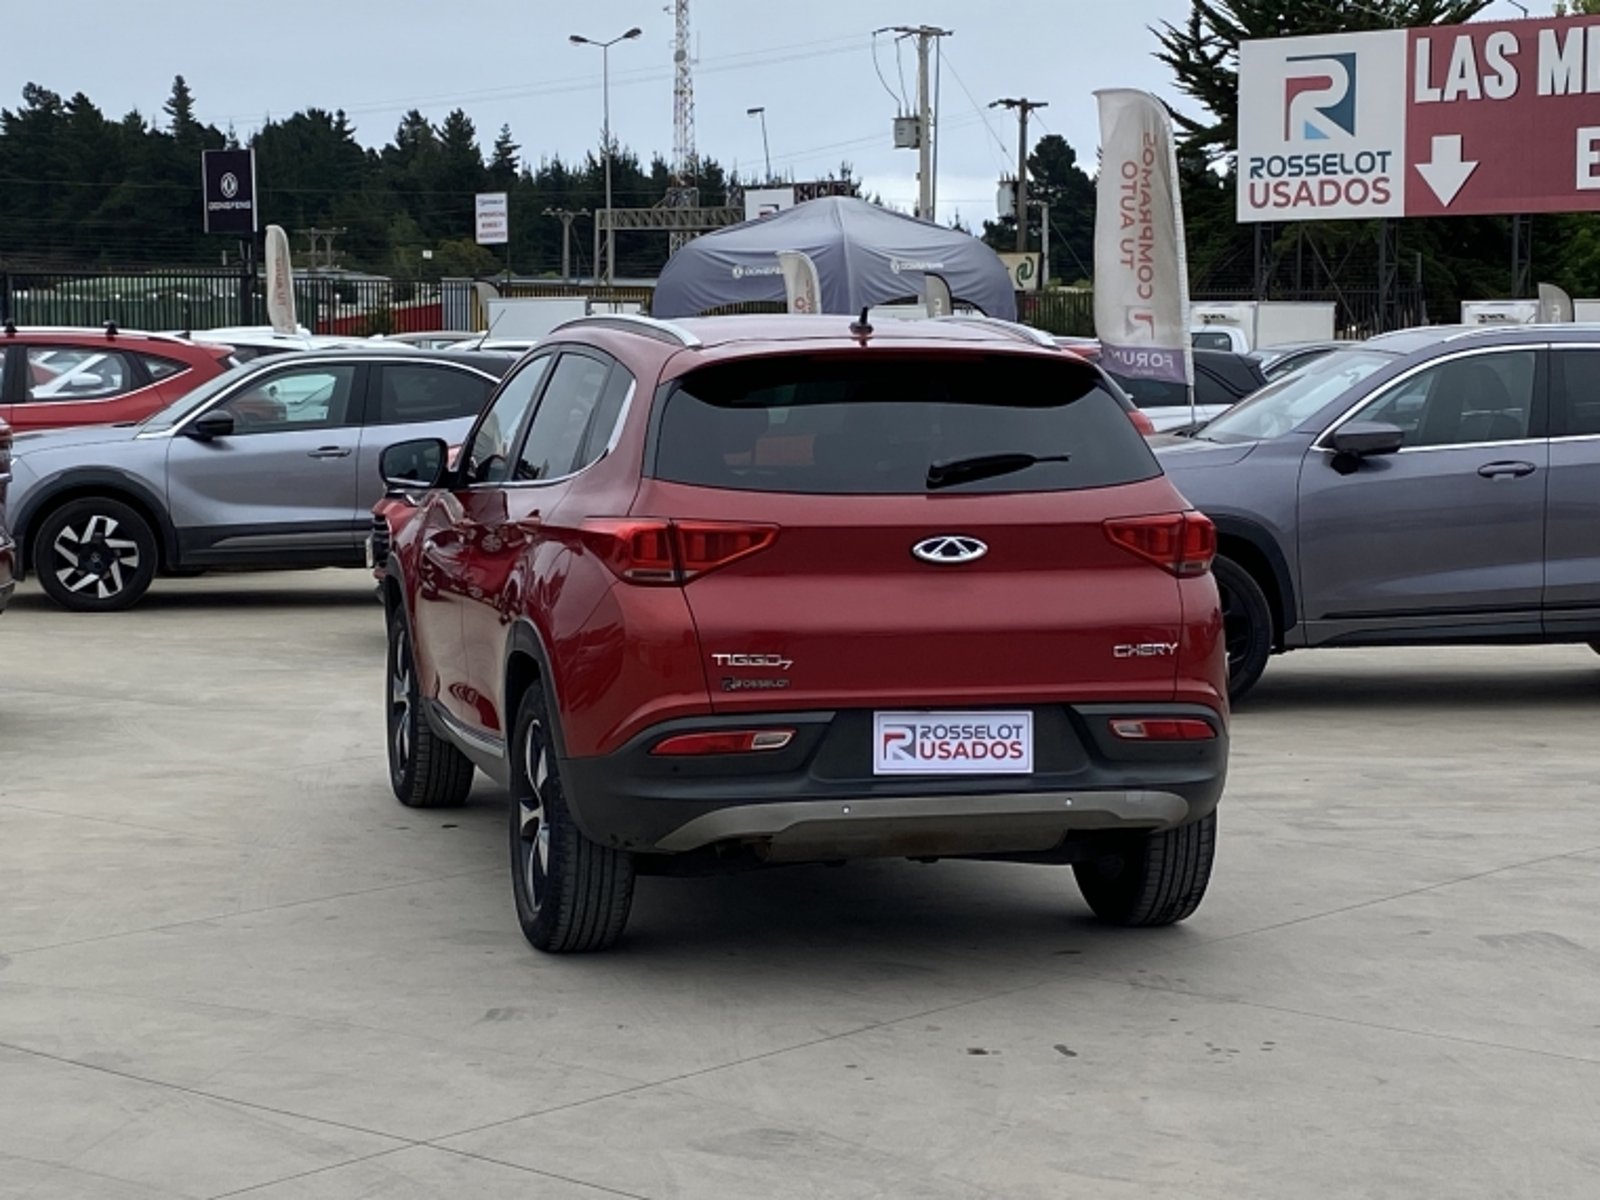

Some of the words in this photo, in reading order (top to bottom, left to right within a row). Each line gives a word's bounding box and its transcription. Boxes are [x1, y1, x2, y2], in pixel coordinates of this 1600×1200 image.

[1414, 31, 1520, 103] LAS
[1250, 151, 1391, 178] ROSSELOT
[1249, 177, 1391, 208] USADOS
[1113, 642, 1178, 657] CHERY
[919, 724, 1024, 740] ROSSELOT
[920, 741, 1024, 760] USADOS
